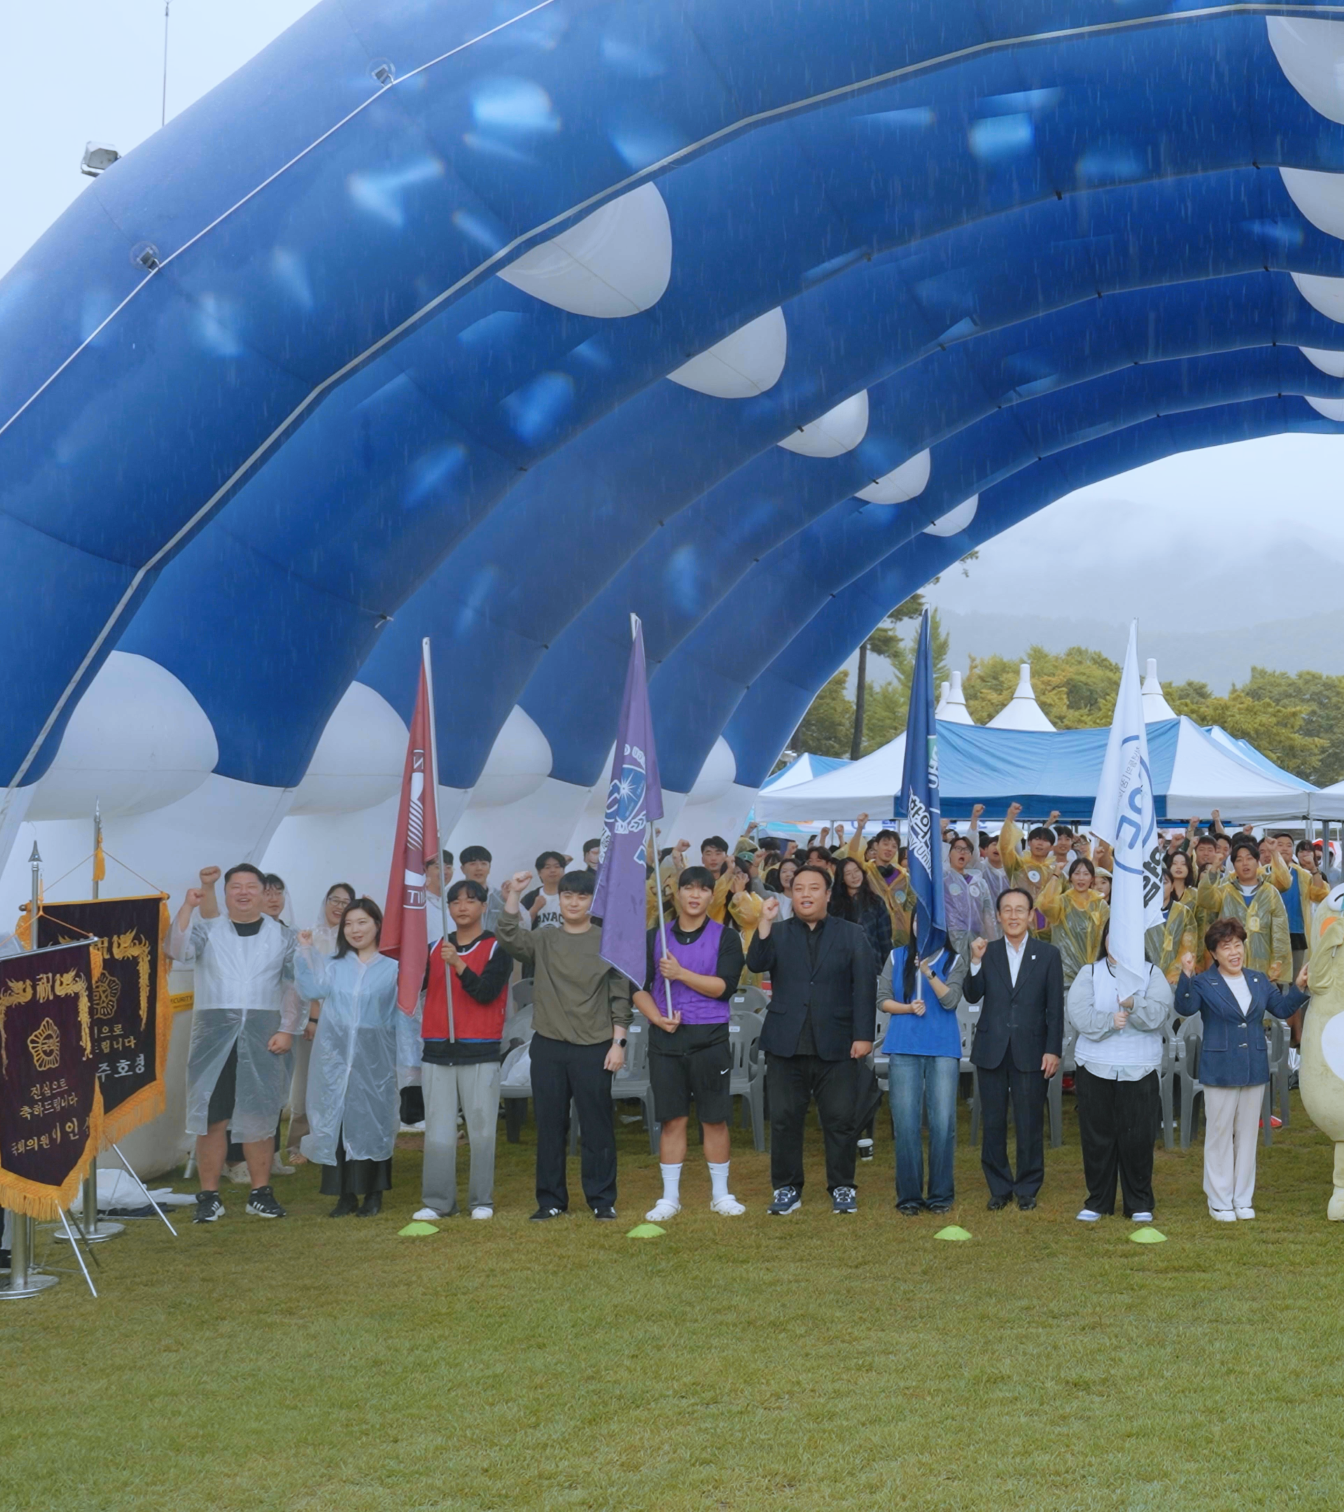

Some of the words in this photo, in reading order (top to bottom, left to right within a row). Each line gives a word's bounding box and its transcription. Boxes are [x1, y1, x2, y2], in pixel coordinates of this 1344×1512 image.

[36, 973, 53, 1003] 祝
[94, 1024, 124, 1040] 으로
[95, 1035, 137, 1054] 립니다
[30, 1078, 69, 1100] 진심으로
[19, 1092, 78, 1120] 축하드립니다
